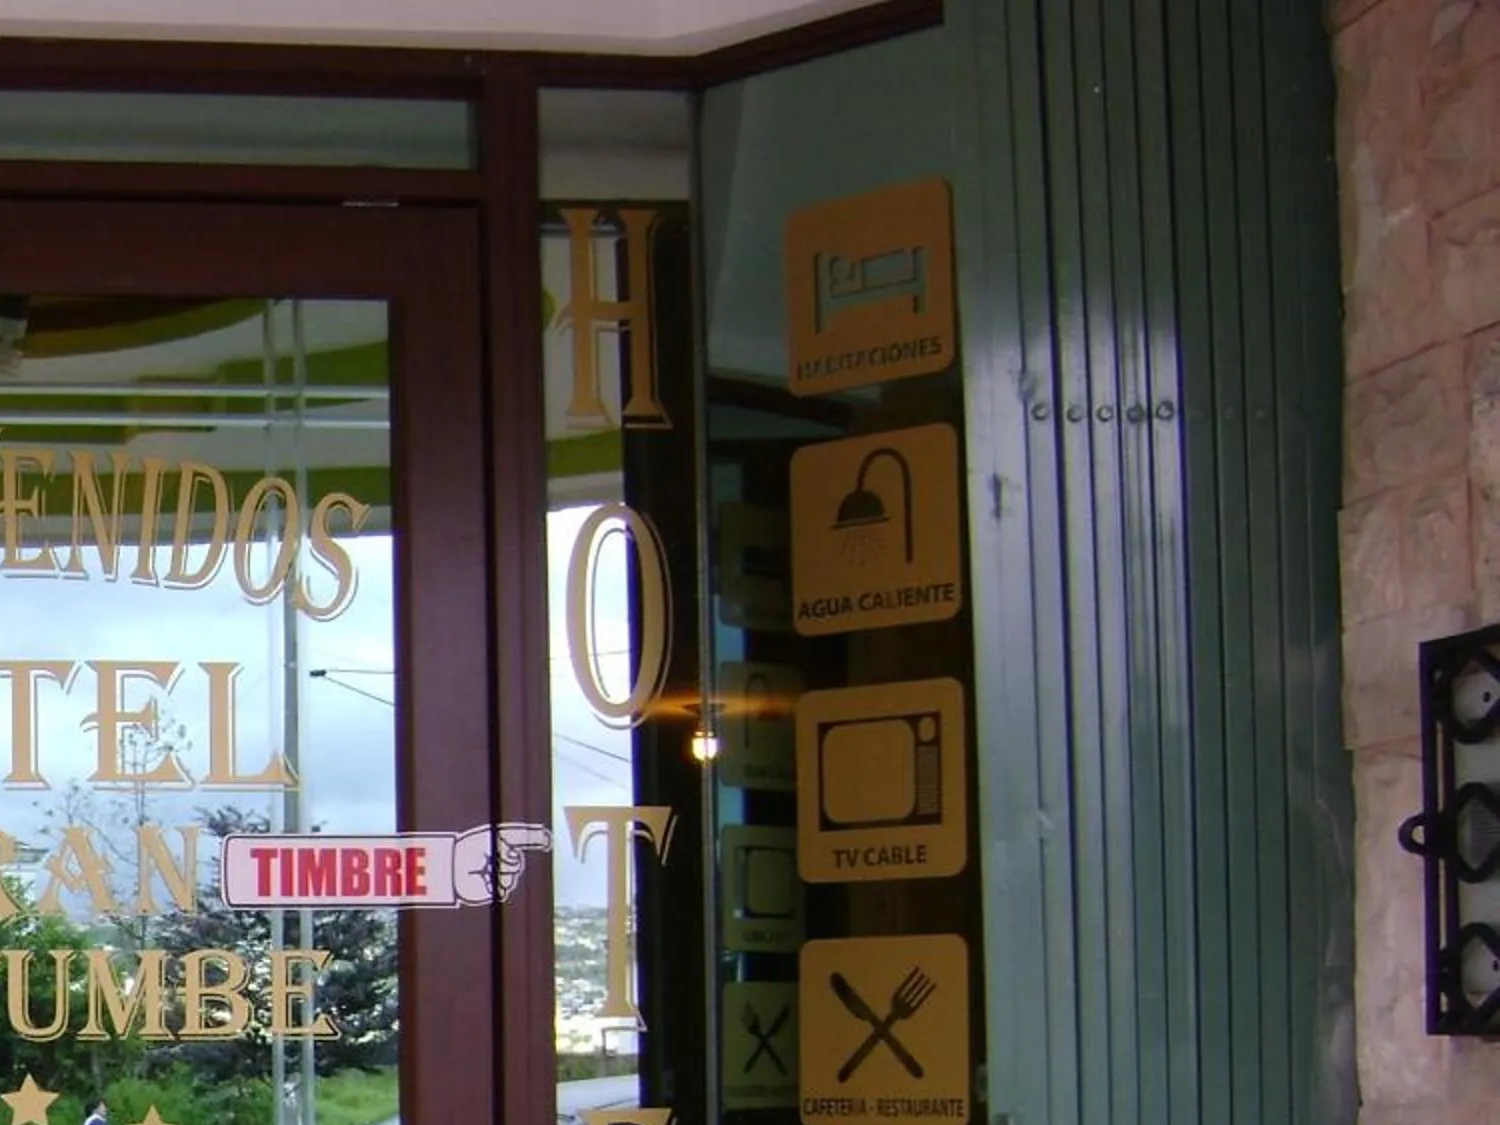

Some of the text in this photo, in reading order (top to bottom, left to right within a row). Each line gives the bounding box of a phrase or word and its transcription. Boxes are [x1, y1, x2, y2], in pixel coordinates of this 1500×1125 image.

[798, 583, 954, 620] AGUA CALIENTE
[251, 847, 427, 897] TIMBRE
[833, 845, 927, 868] TV CABLE
